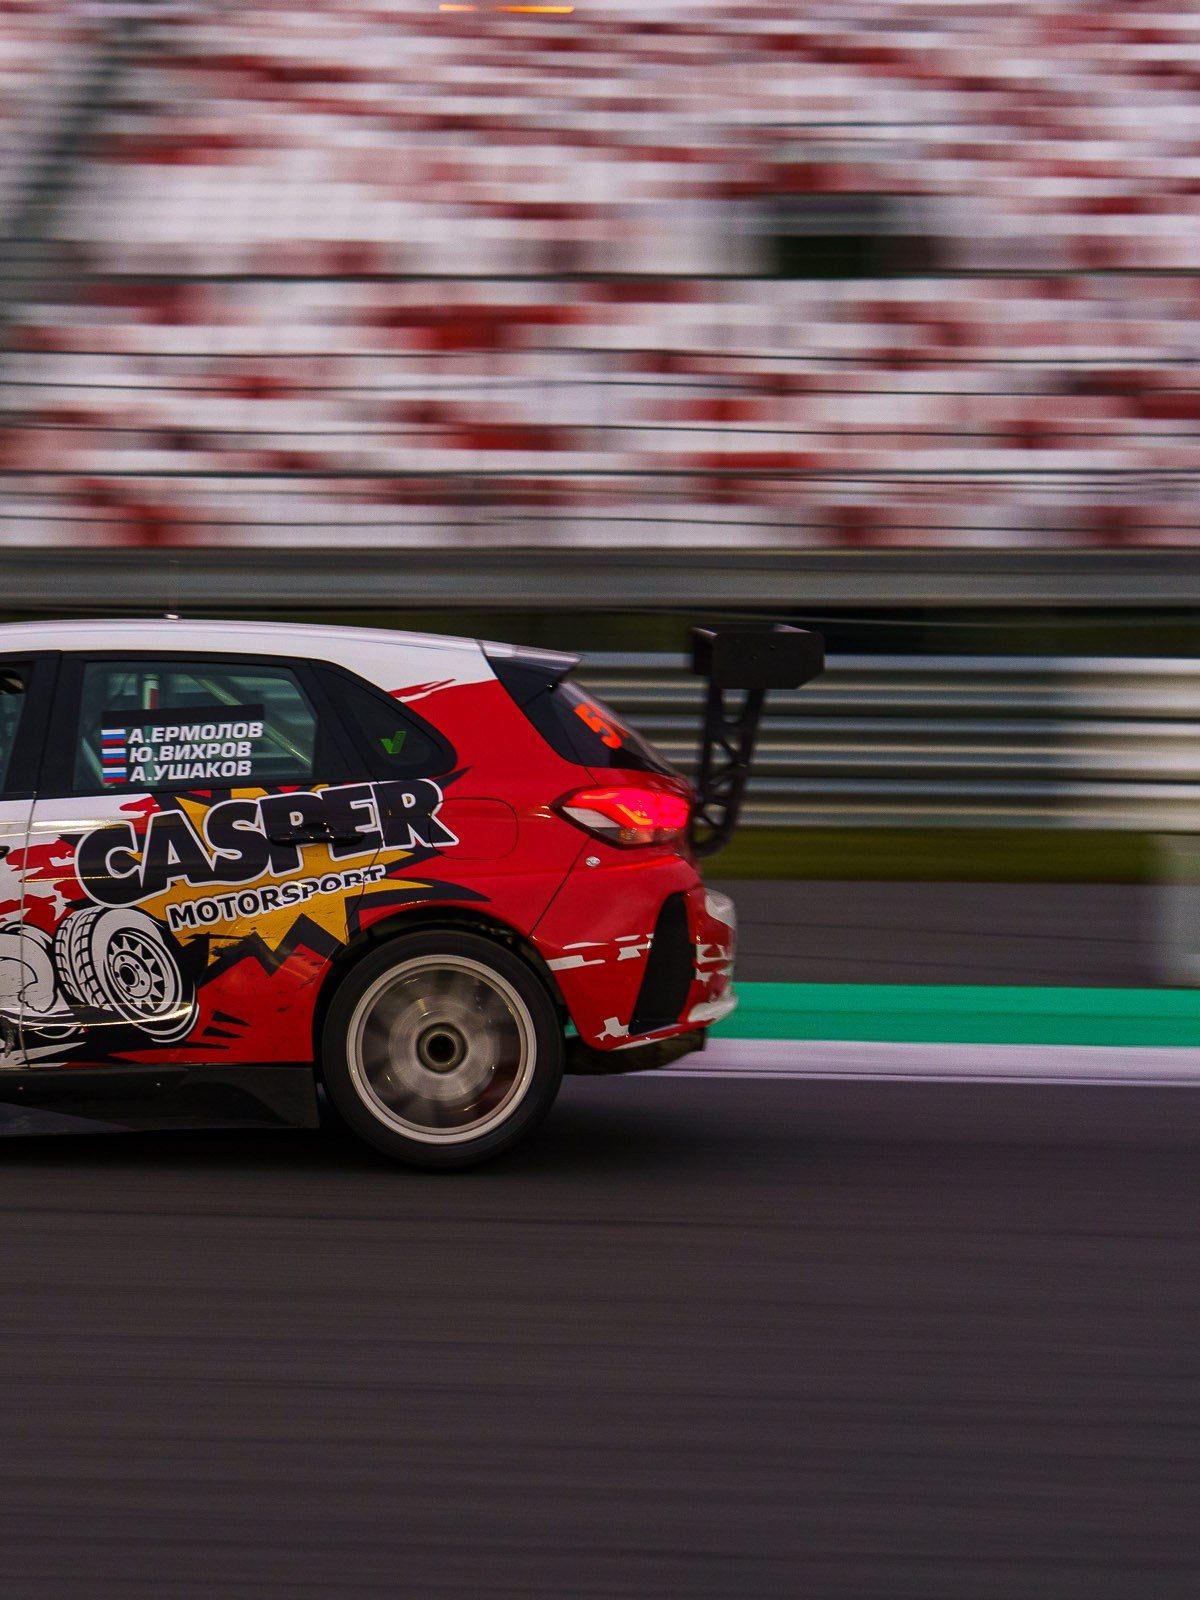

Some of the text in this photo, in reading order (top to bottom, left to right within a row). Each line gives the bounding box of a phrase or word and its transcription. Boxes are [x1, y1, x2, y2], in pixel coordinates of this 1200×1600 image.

[128, 722, 264, 744] А.ЕРМОЛОВ
[129, 741, 253, 763] Ю.ВИХРОВ
[130, 760, 253, 782] А.УШАКОВ
[74, 778, 459, 908] CASPER
[166, 864, 387, 932] MOTORSPORT
